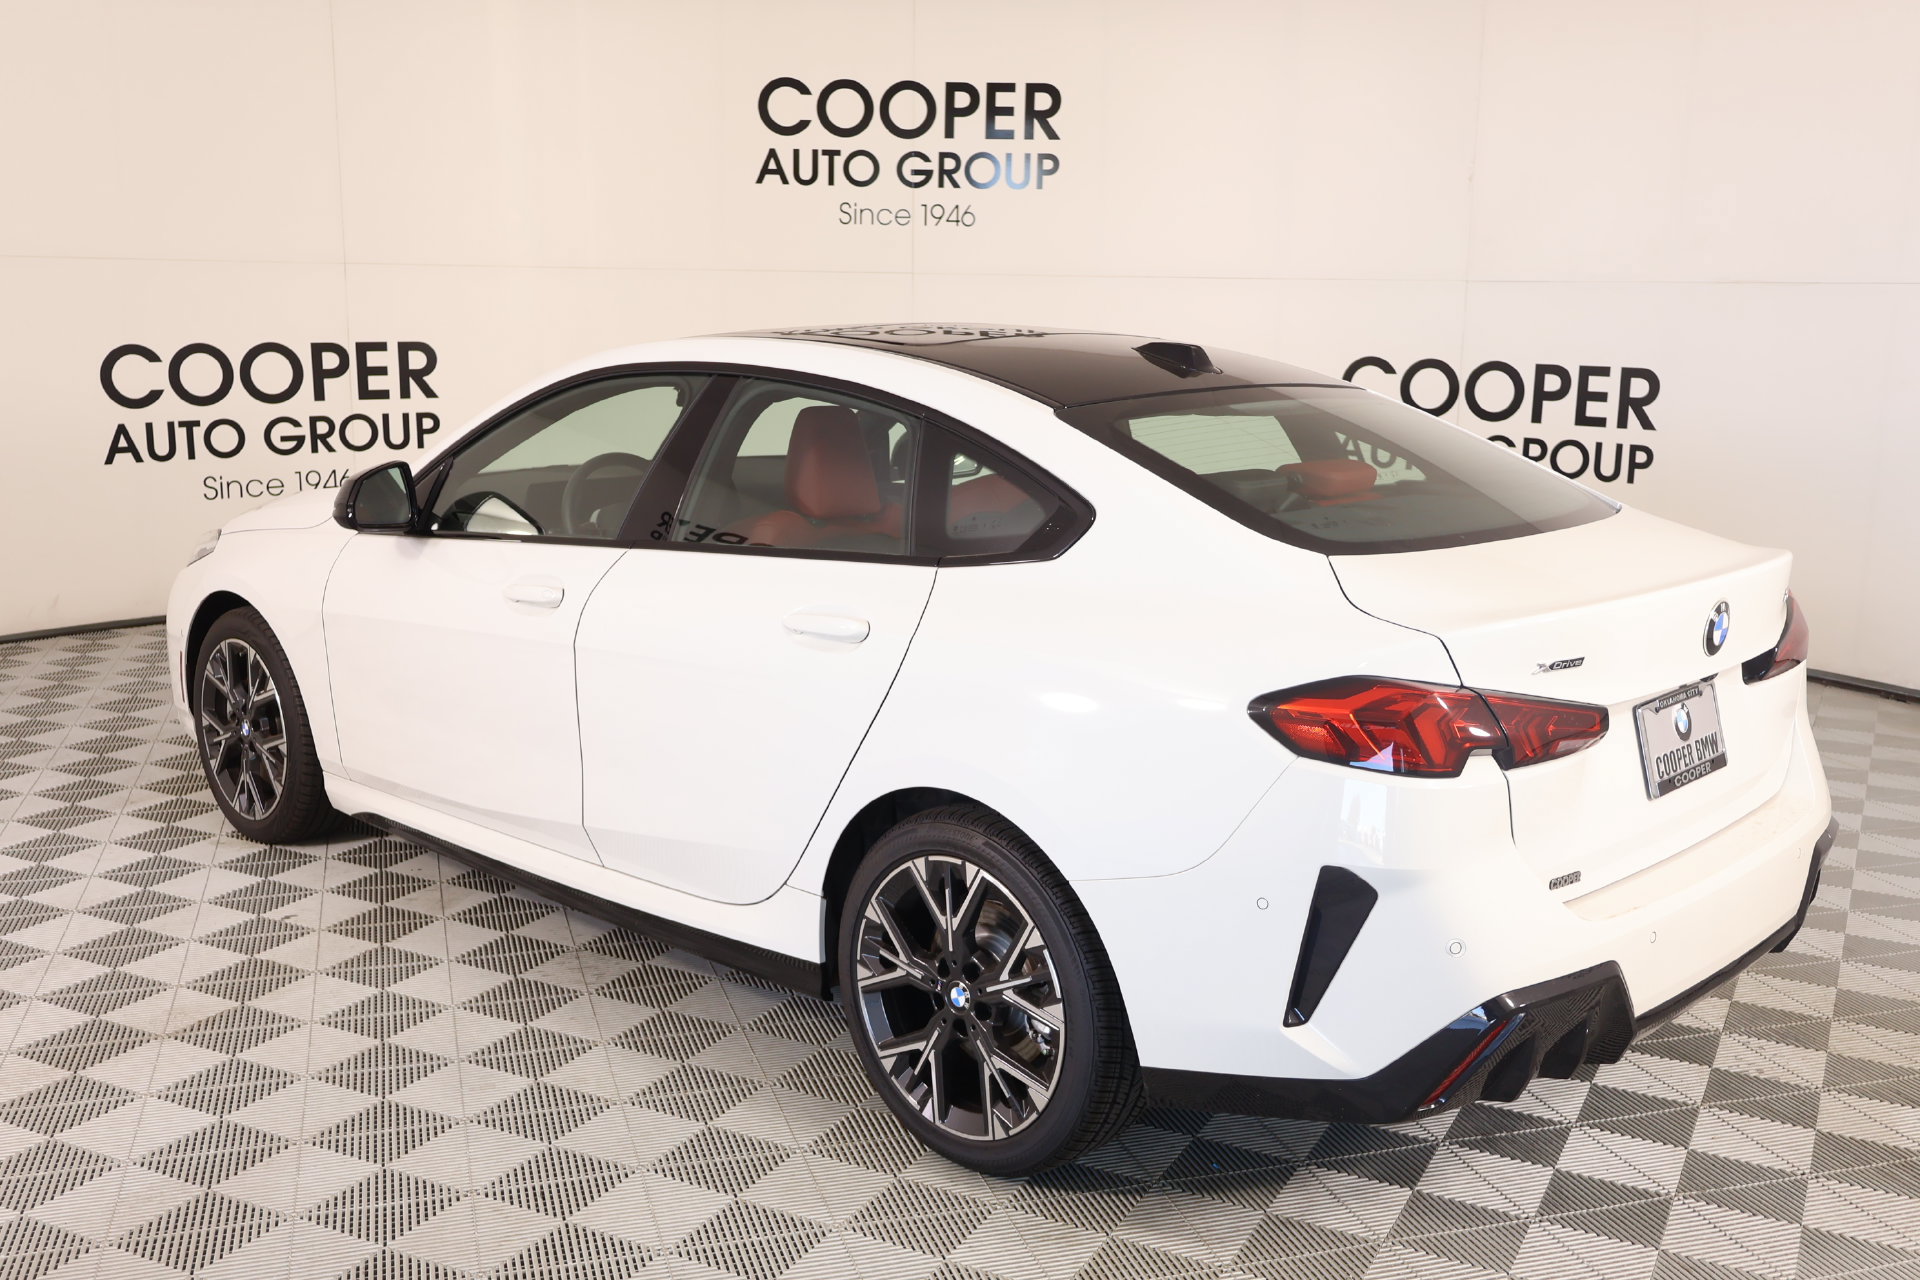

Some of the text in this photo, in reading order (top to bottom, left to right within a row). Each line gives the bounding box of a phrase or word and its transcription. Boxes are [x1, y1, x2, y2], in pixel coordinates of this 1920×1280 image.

[758, 77, 1061, 140] COOPER
[756, 148, 1060, 189] AUTO GROUP
[839, 202, 975, 227] Since 1946
[100, 342, 439, 409] COOPER
[104, 412, 441, 465] AUTO GROUP
[203, 475, 284, 500] Since
[1687, 687, 1699, 697] CITY
[1656, 732, 1719, 779] COOPER BMW
[1675, 762, 1711, 786] COOPER
